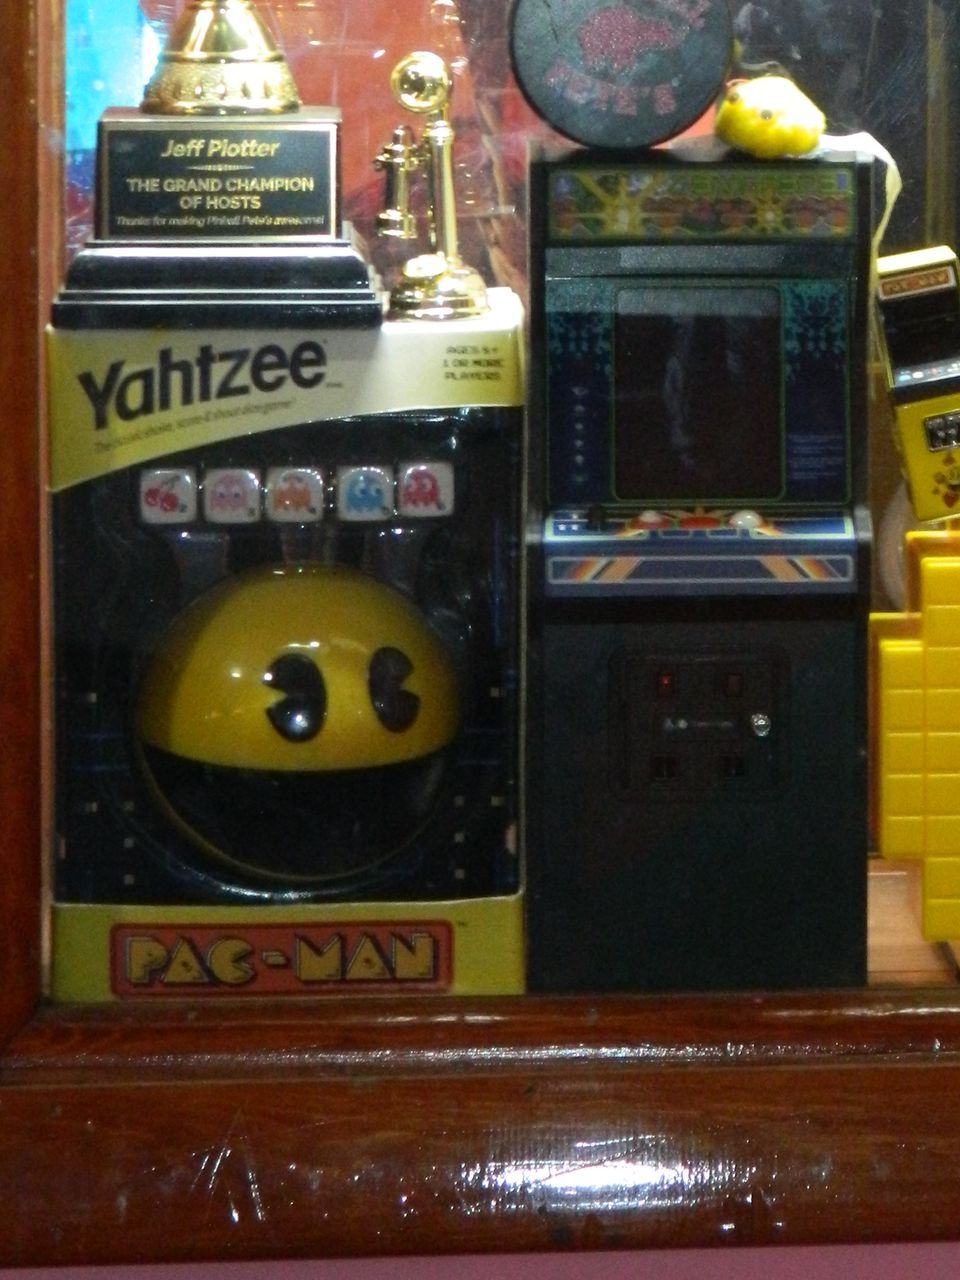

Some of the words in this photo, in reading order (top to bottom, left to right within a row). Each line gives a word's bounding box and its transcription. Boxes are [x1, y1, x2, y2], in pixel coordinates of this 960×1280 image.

[161, 138, 205, 158] Jeff
[127, 177, 161, 193] THE
[163, 177, 223, 193] GRAND
[225, 176, 315, 193] CHAMPION
[179, 196, 202, 210] OF
[205, 195, 262, 210] HOSTS
[446, 345, 479, 354] AGES
[444, 371, 501, 381] PLAYERS
[78, 340, 328, 432] Yahtzee
[125, 931, 437, 986] PAC-MAN
